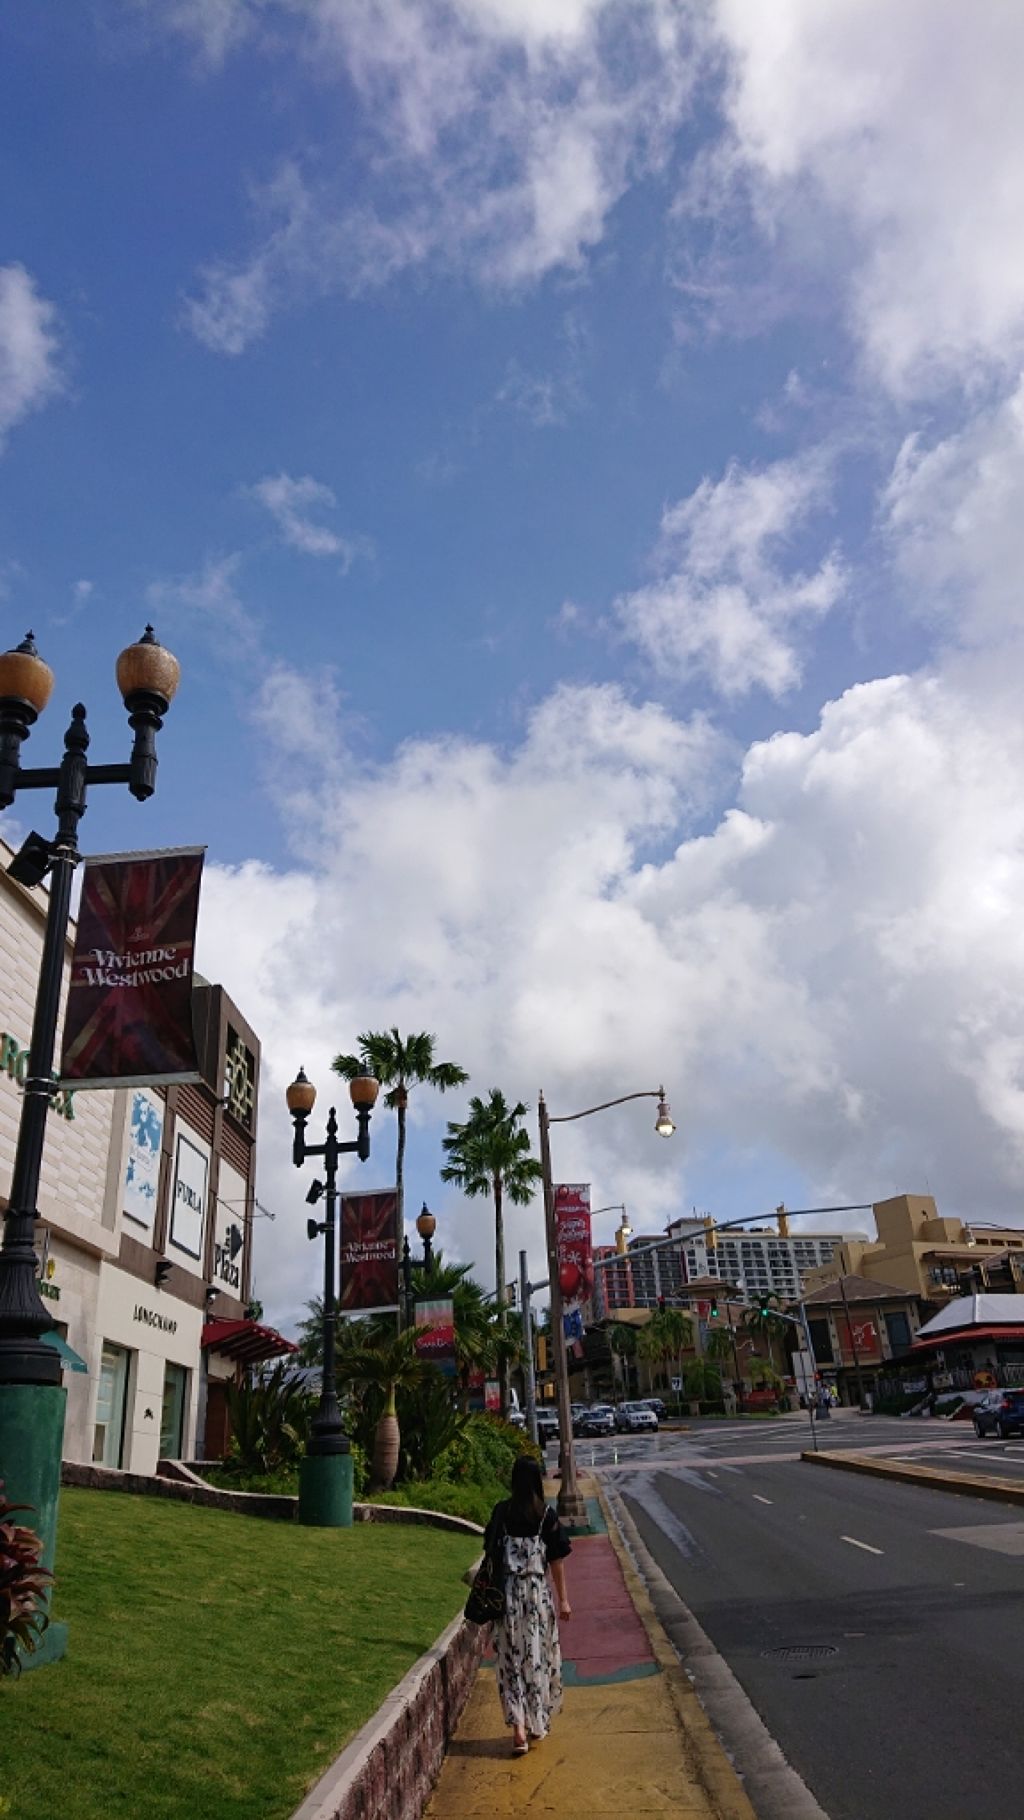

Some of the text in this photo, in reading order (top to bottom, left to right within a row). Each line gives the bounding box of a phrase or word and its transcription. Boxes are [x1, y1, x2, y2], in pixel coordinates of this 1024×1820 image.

[80, 957, 190, 987] Westwood
[88, 946, 177, 968] Vivienne
[175, 1179, 202, 1215] FURLA
[214, 1243, 239, 1289] Plaza
[132, 1303, 178, 1336] LONGCHAMP
